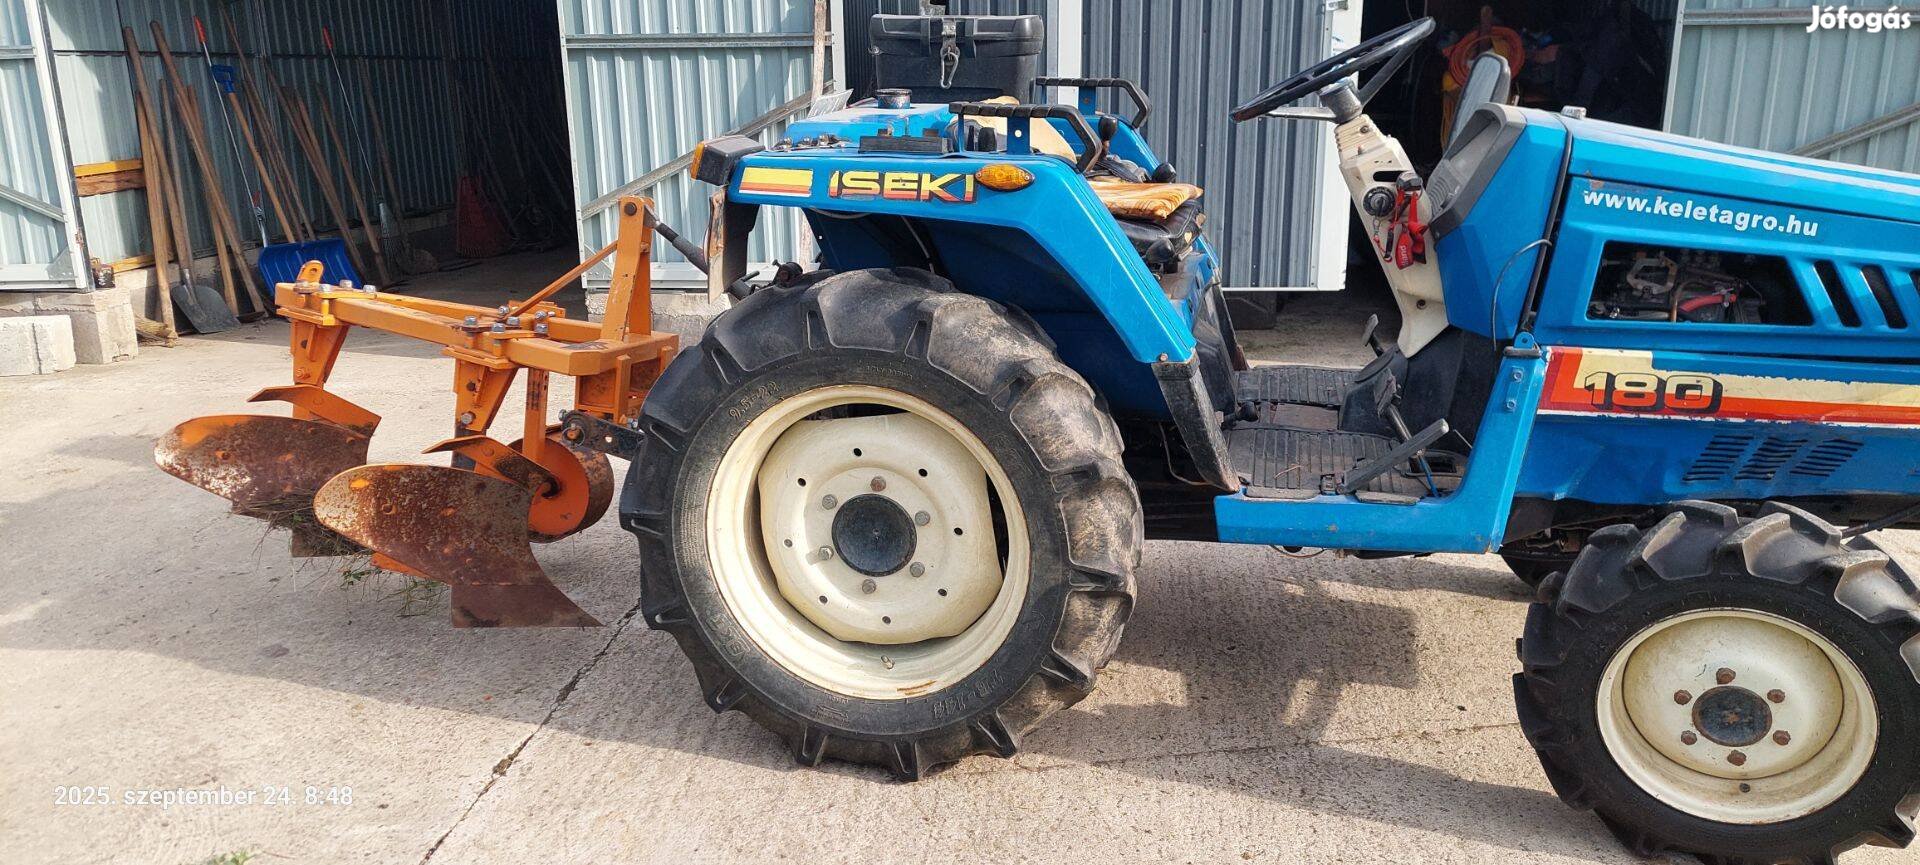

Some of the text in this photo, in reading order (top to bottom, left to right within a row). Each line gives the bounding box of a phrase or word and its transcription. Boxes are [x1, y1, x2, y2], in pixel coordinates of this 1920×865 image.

[829, 169, 976, 203] ISEKI
[1583, 190, 1819, 237] www.keletagro.hu
[1584, 371, 1723, 414] 180
